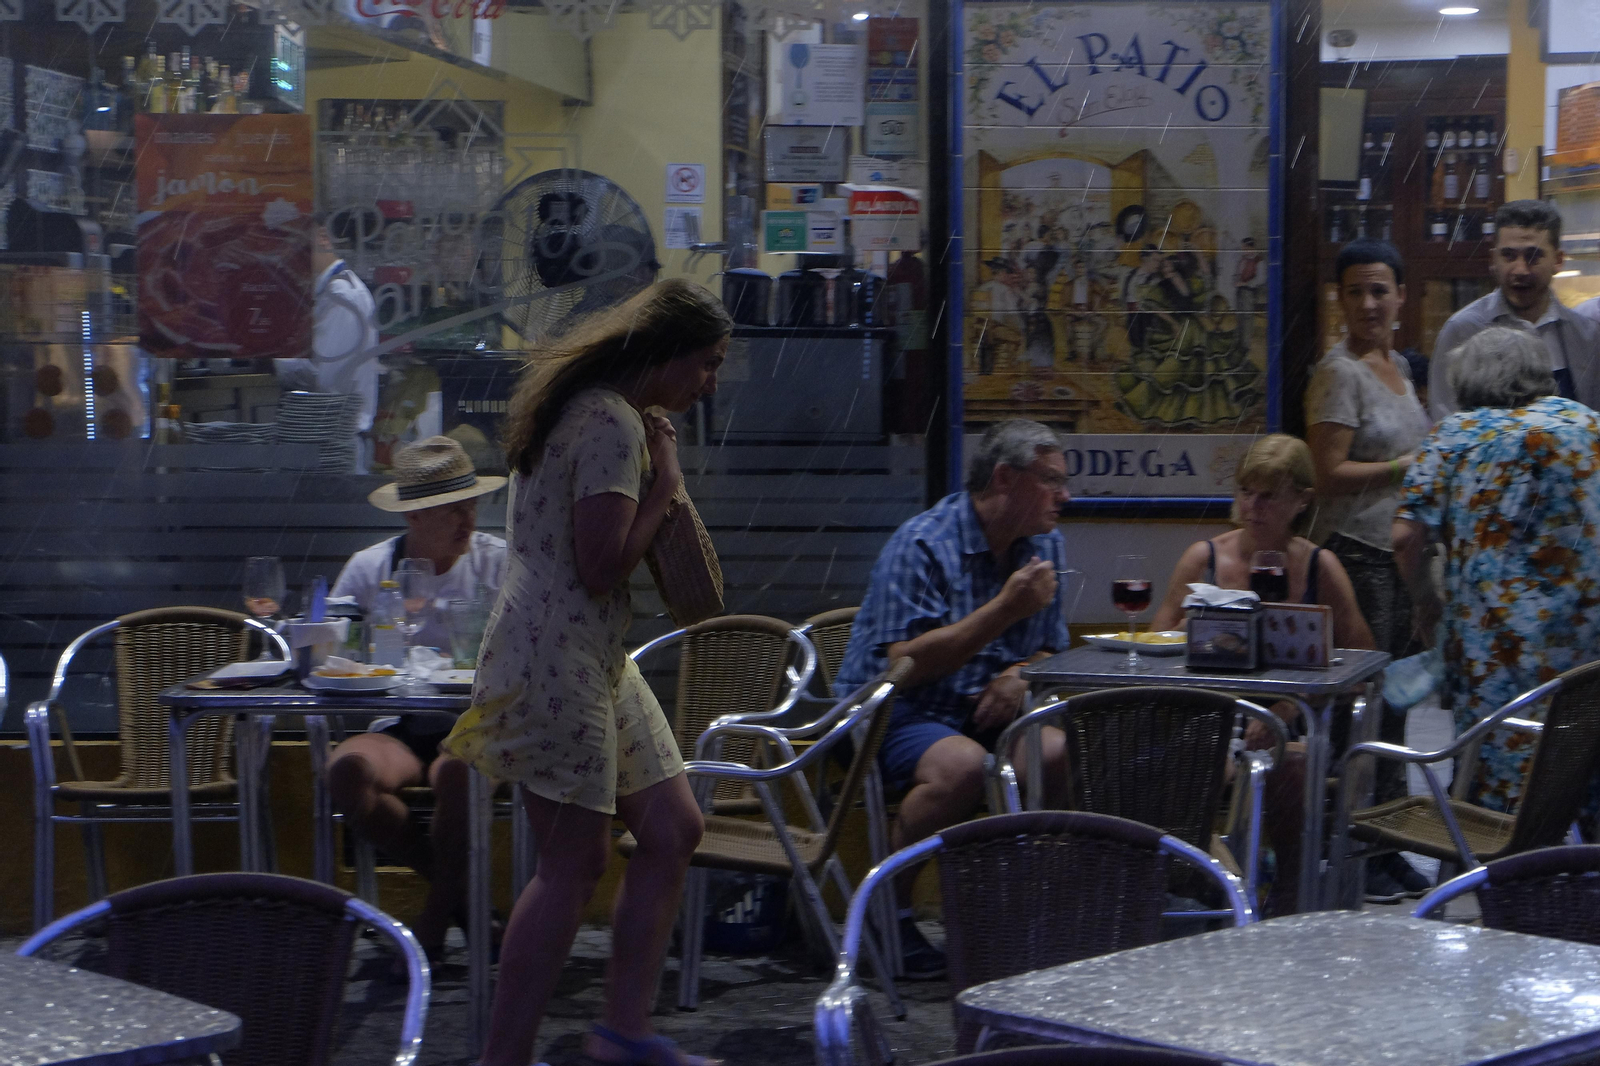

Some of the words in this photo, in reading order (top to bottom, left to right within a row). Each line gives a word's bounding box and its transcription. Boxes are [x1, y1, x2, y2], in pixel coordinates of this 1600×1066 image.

[995, 55, 1071, 119] EL
[1076, 31, 1231, 123] PATIO
[1062, 448, 1198, 478] ODEGA
